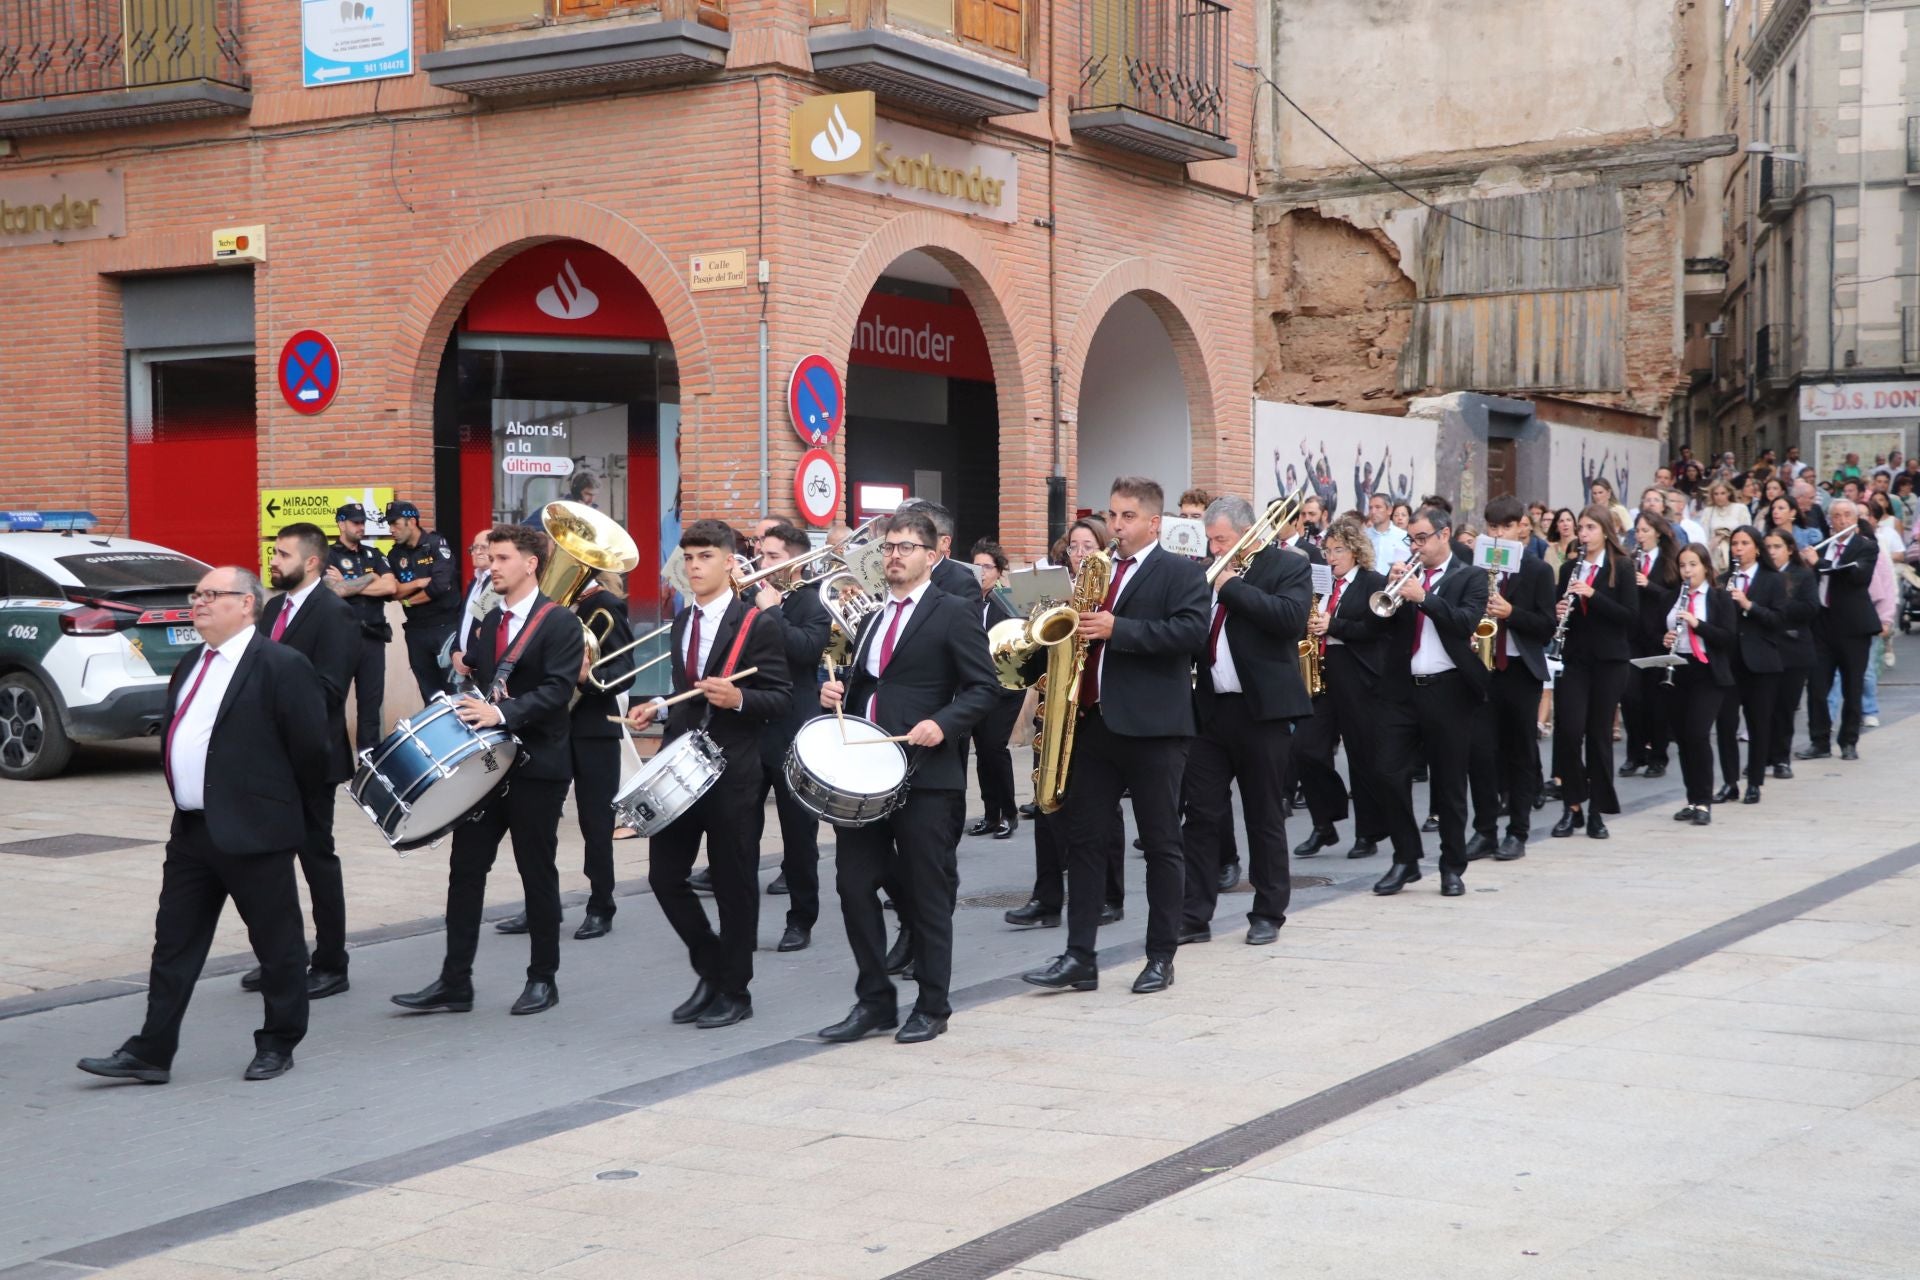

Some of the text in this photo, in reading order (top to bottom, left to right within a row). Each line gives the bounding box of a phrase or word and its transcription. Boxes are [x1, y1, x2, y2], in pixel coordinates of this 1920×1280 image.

[875, 141, 1006, 207] Santander
[709, 260, 730, 270] Calle
[693, 271, 744, 285] Pasaje del Toril
[1832, 391, 1869, 411] D.S.
[506, 421, 567, 439] Ahora sí,
[506, 439, 532, 453] a la
[507, 458, 551, 473] última
[283, 496, 329, 507] MIRADOR
[283, 508, 292, 516] DE
[293, 508, 305, 516] LAS
[85, 555, 149, 563] GUARDIA
[15, 624, 39, 640] 062
[175, 629, 197, 641] PGC
